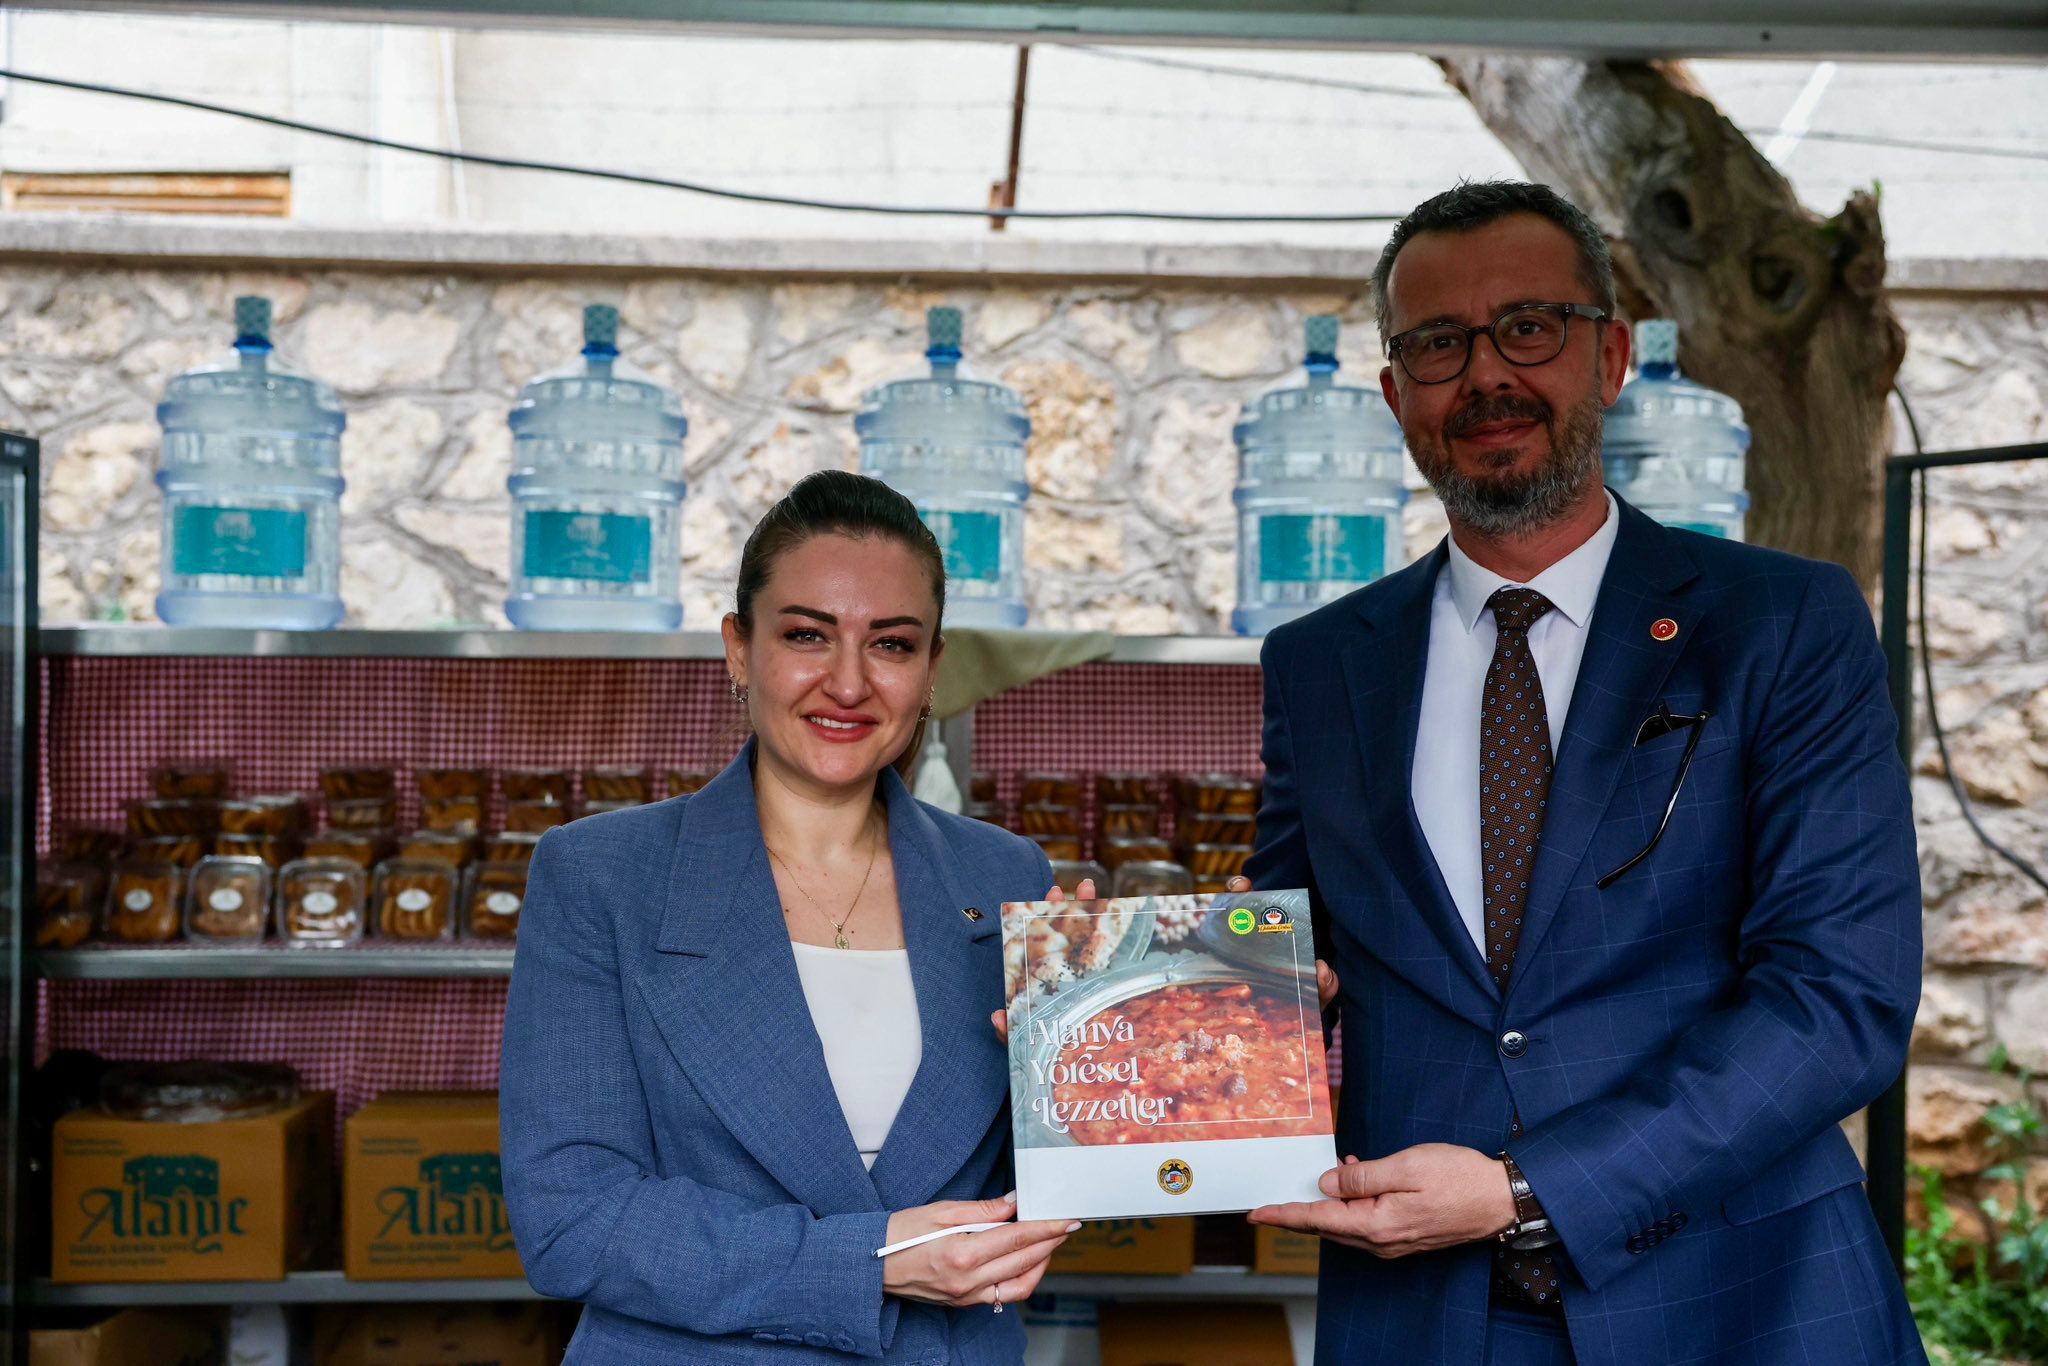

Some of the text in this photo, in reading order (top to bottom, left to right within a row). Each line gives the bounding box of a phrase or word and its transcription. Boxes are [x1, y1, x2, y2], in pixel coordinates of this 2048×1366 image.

[1029, 1015, 1135, 1051] Alanya
[1030, 1053, 1140, 1086] Yöresel
[1031, 1093, 1174, 1134] Lezzetler
